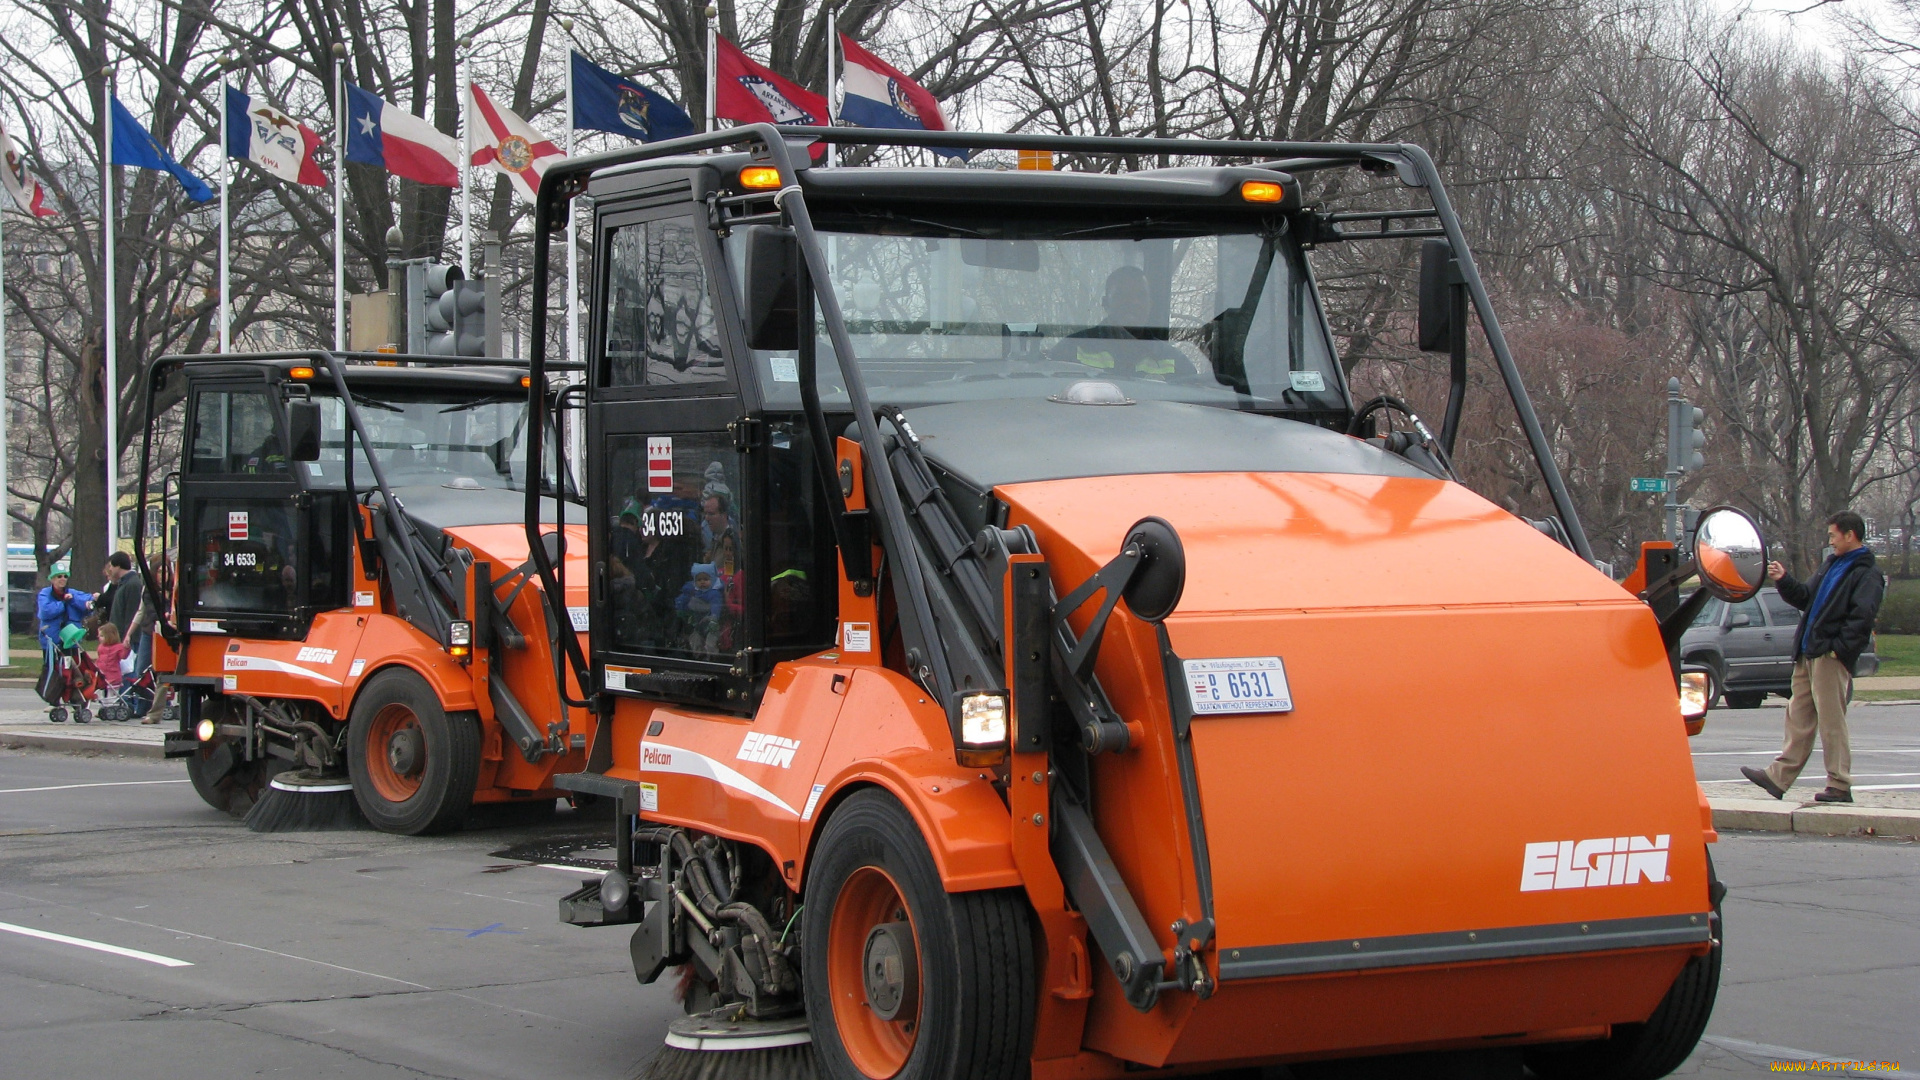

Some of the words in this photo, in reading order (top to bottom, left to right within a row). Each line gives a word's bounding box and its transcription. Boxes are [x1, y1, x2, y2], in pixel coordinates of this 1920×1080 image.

[761, 90, 792, 110] ARKANSAS
[642, 512, 656, 536] 34
[659, 511, 684, 536] 6531
[224, 553, 234, 566] 34
[236, 553, 256, 566] 6533
[572, 612, 589, 625] 653
[226, 658, 248, 667] Pelican
[296, 646, 338, 664] ELGIN
[1227, 671, 1274, 698] 6531
[1245, 700, 1289, 708] REPRESENTATION
[643, 748, 672, 766] Pelican
[736, 731, 801, 769] ELGIN
[1520, 834, 1670, 892] ELGIN
